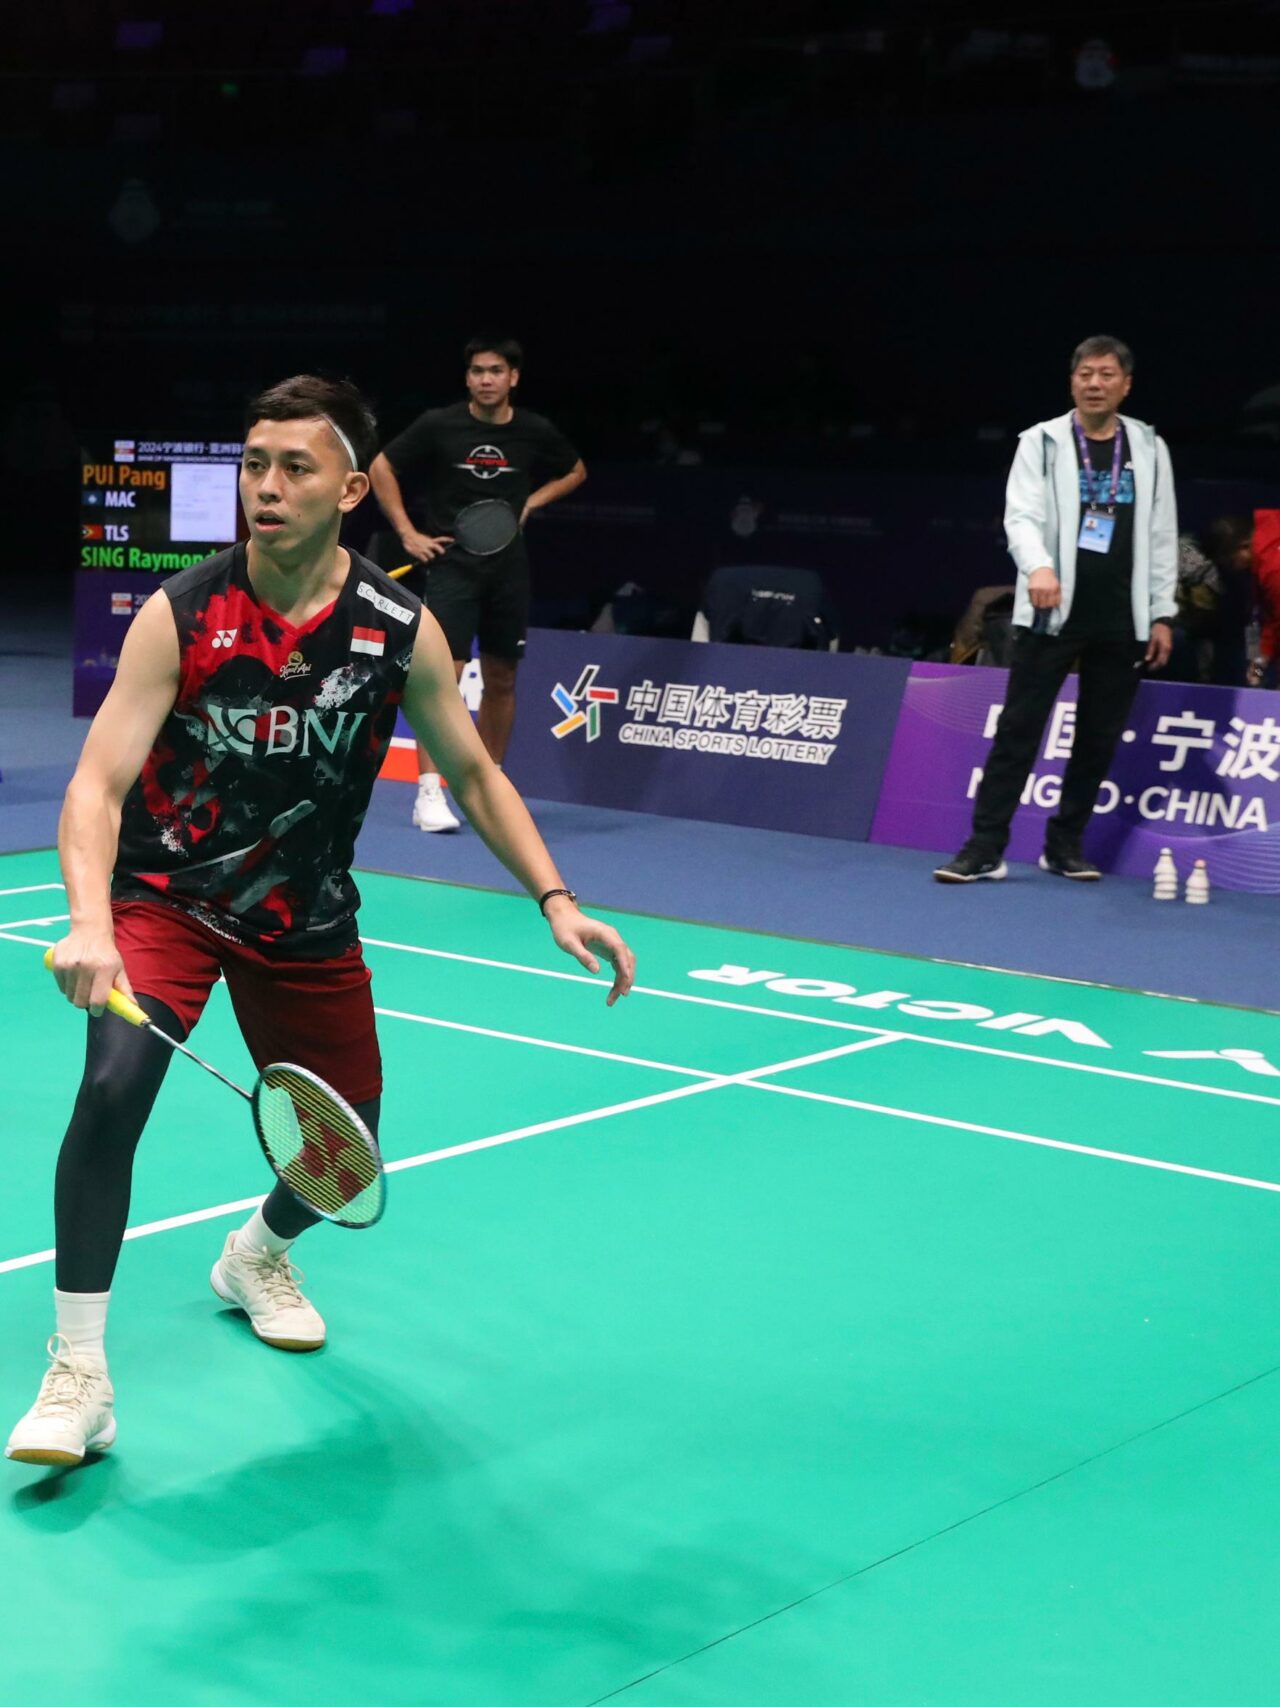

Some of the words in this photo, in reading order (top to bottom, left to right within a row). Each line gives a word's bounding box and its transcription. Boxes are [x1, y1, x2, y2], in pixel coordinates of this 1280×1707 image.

[82, 465, 113, 486] PUI
[119, 466, 166, 491] Pang
[104, 491, 136, 508] MAC
[104, 525, 130, 541] TLS
[81, 546, 124, 568] SING
[625, 680, 847, 740] 中国体育彩票
[264, 704, 369, 757] BNI
[619, 723, 674, 746] CHINA
[673, 729, 748, 757] SPORTS
[745, 736, 838, 766] LOTTERY
[687, 964, 1113, 1049] VICTOR
